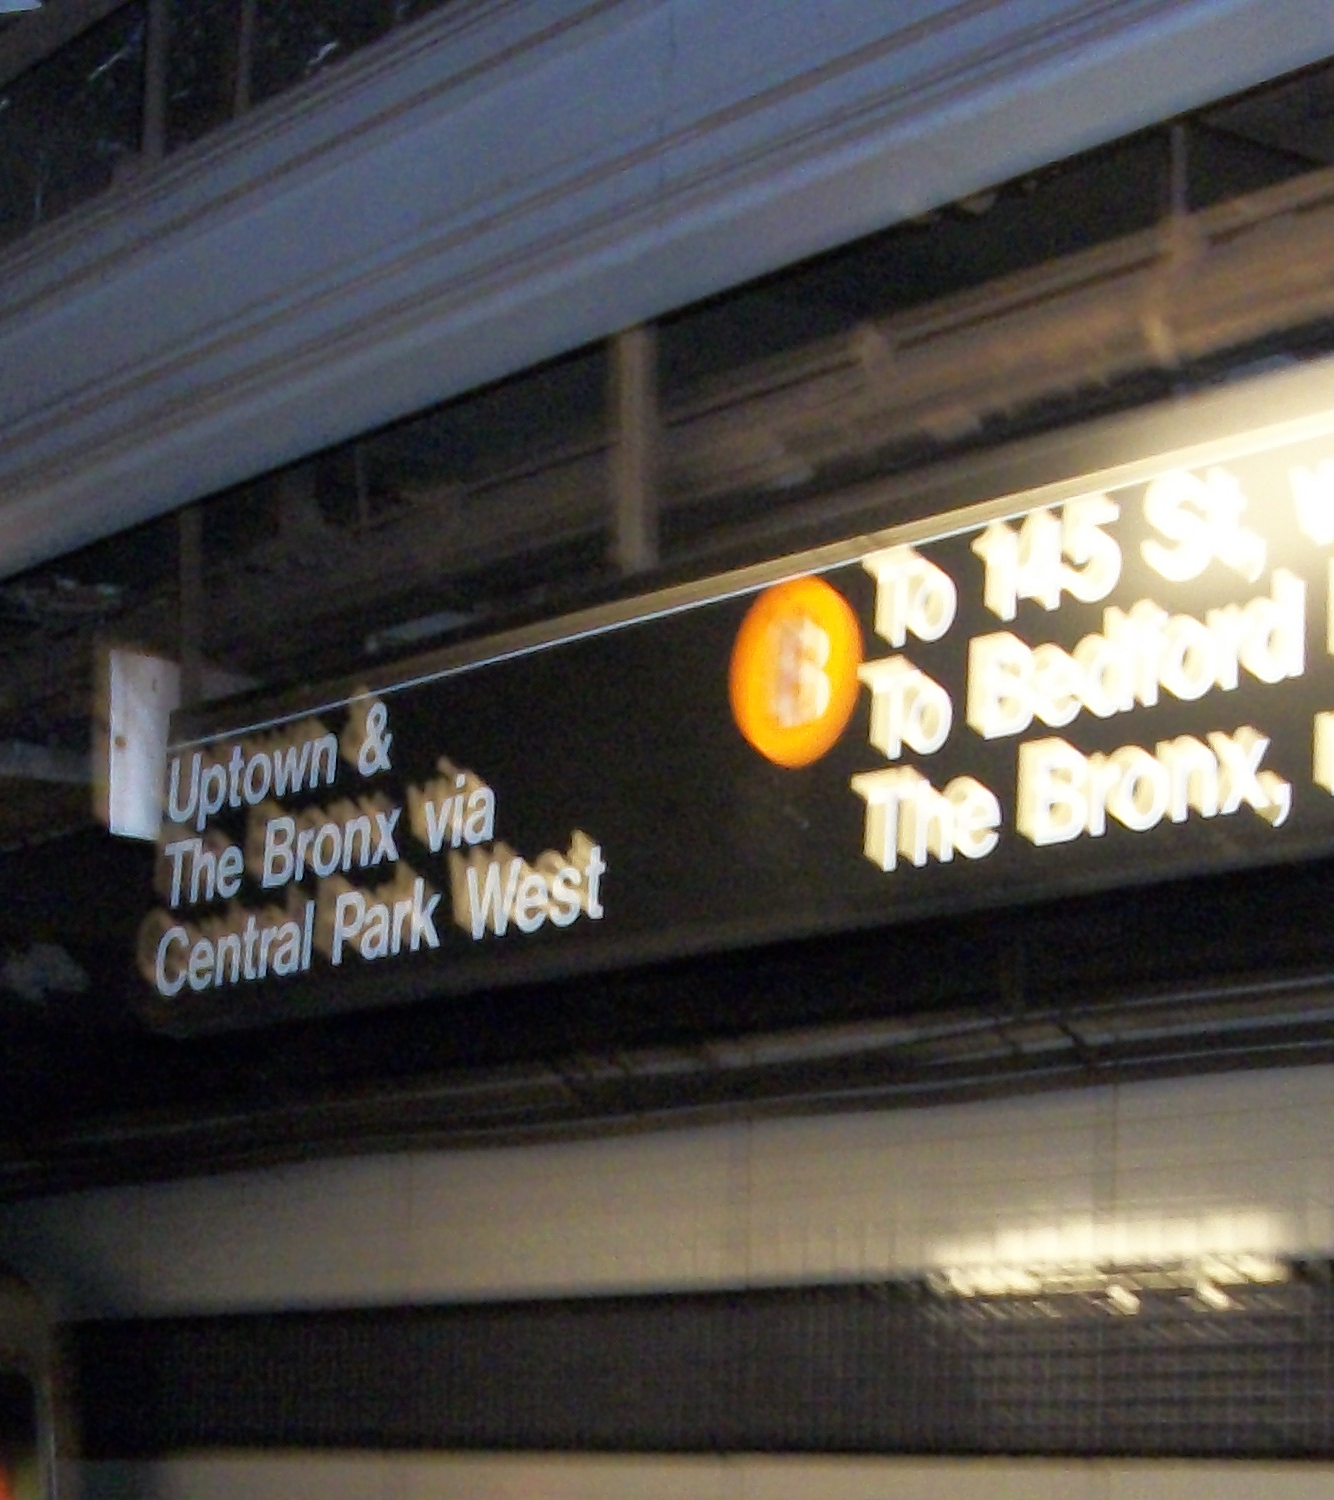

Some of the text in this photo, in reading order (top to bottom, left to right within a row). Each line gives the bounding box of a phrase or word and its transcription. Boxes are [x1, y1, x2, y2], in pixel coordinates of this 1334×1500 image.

[863, 546, 957, 648] To
[972, 492, 1120, 619] 145
[767, 617, 831, 727] B
[857, 656, 953, 760] To
[967, 566, 1307, 740] Bedford
[165, 772, 496, 910] The Bronx via
[168, 700, 393, 831] Uptown &
[850, 766, 1001, 872] The
[1017, 720, 1292, 847] Bronx,
[154, 844, 607, 997] Central Park West
